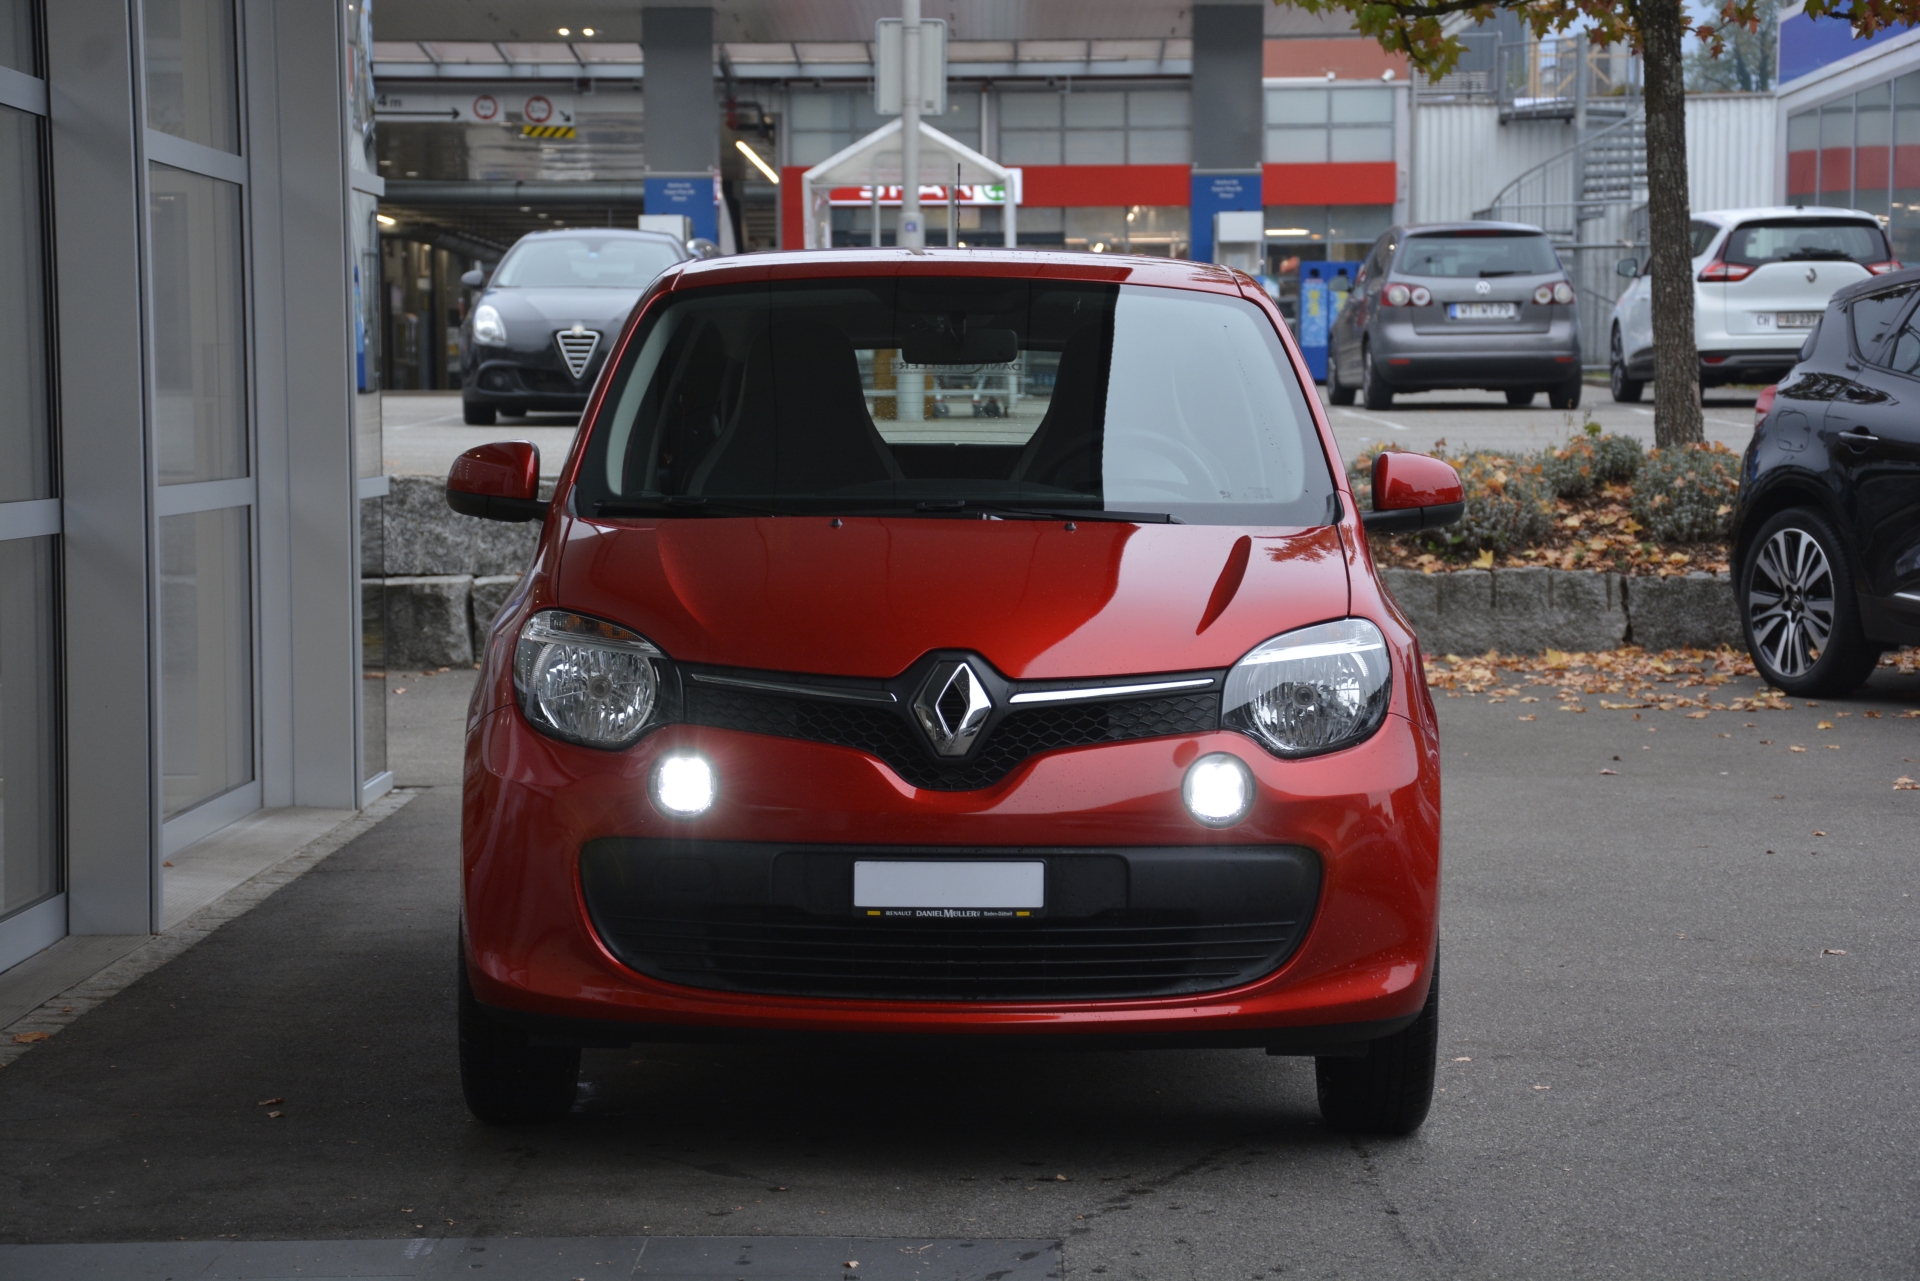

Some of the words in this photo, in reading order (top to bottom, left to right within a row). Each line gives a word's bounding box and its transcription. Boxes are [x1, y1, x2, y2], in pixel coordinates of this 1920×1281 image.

[377, 94, 388, 107] 4
[390, 97, 402, 107] m
[1757, 315, 1770, 327] CH
